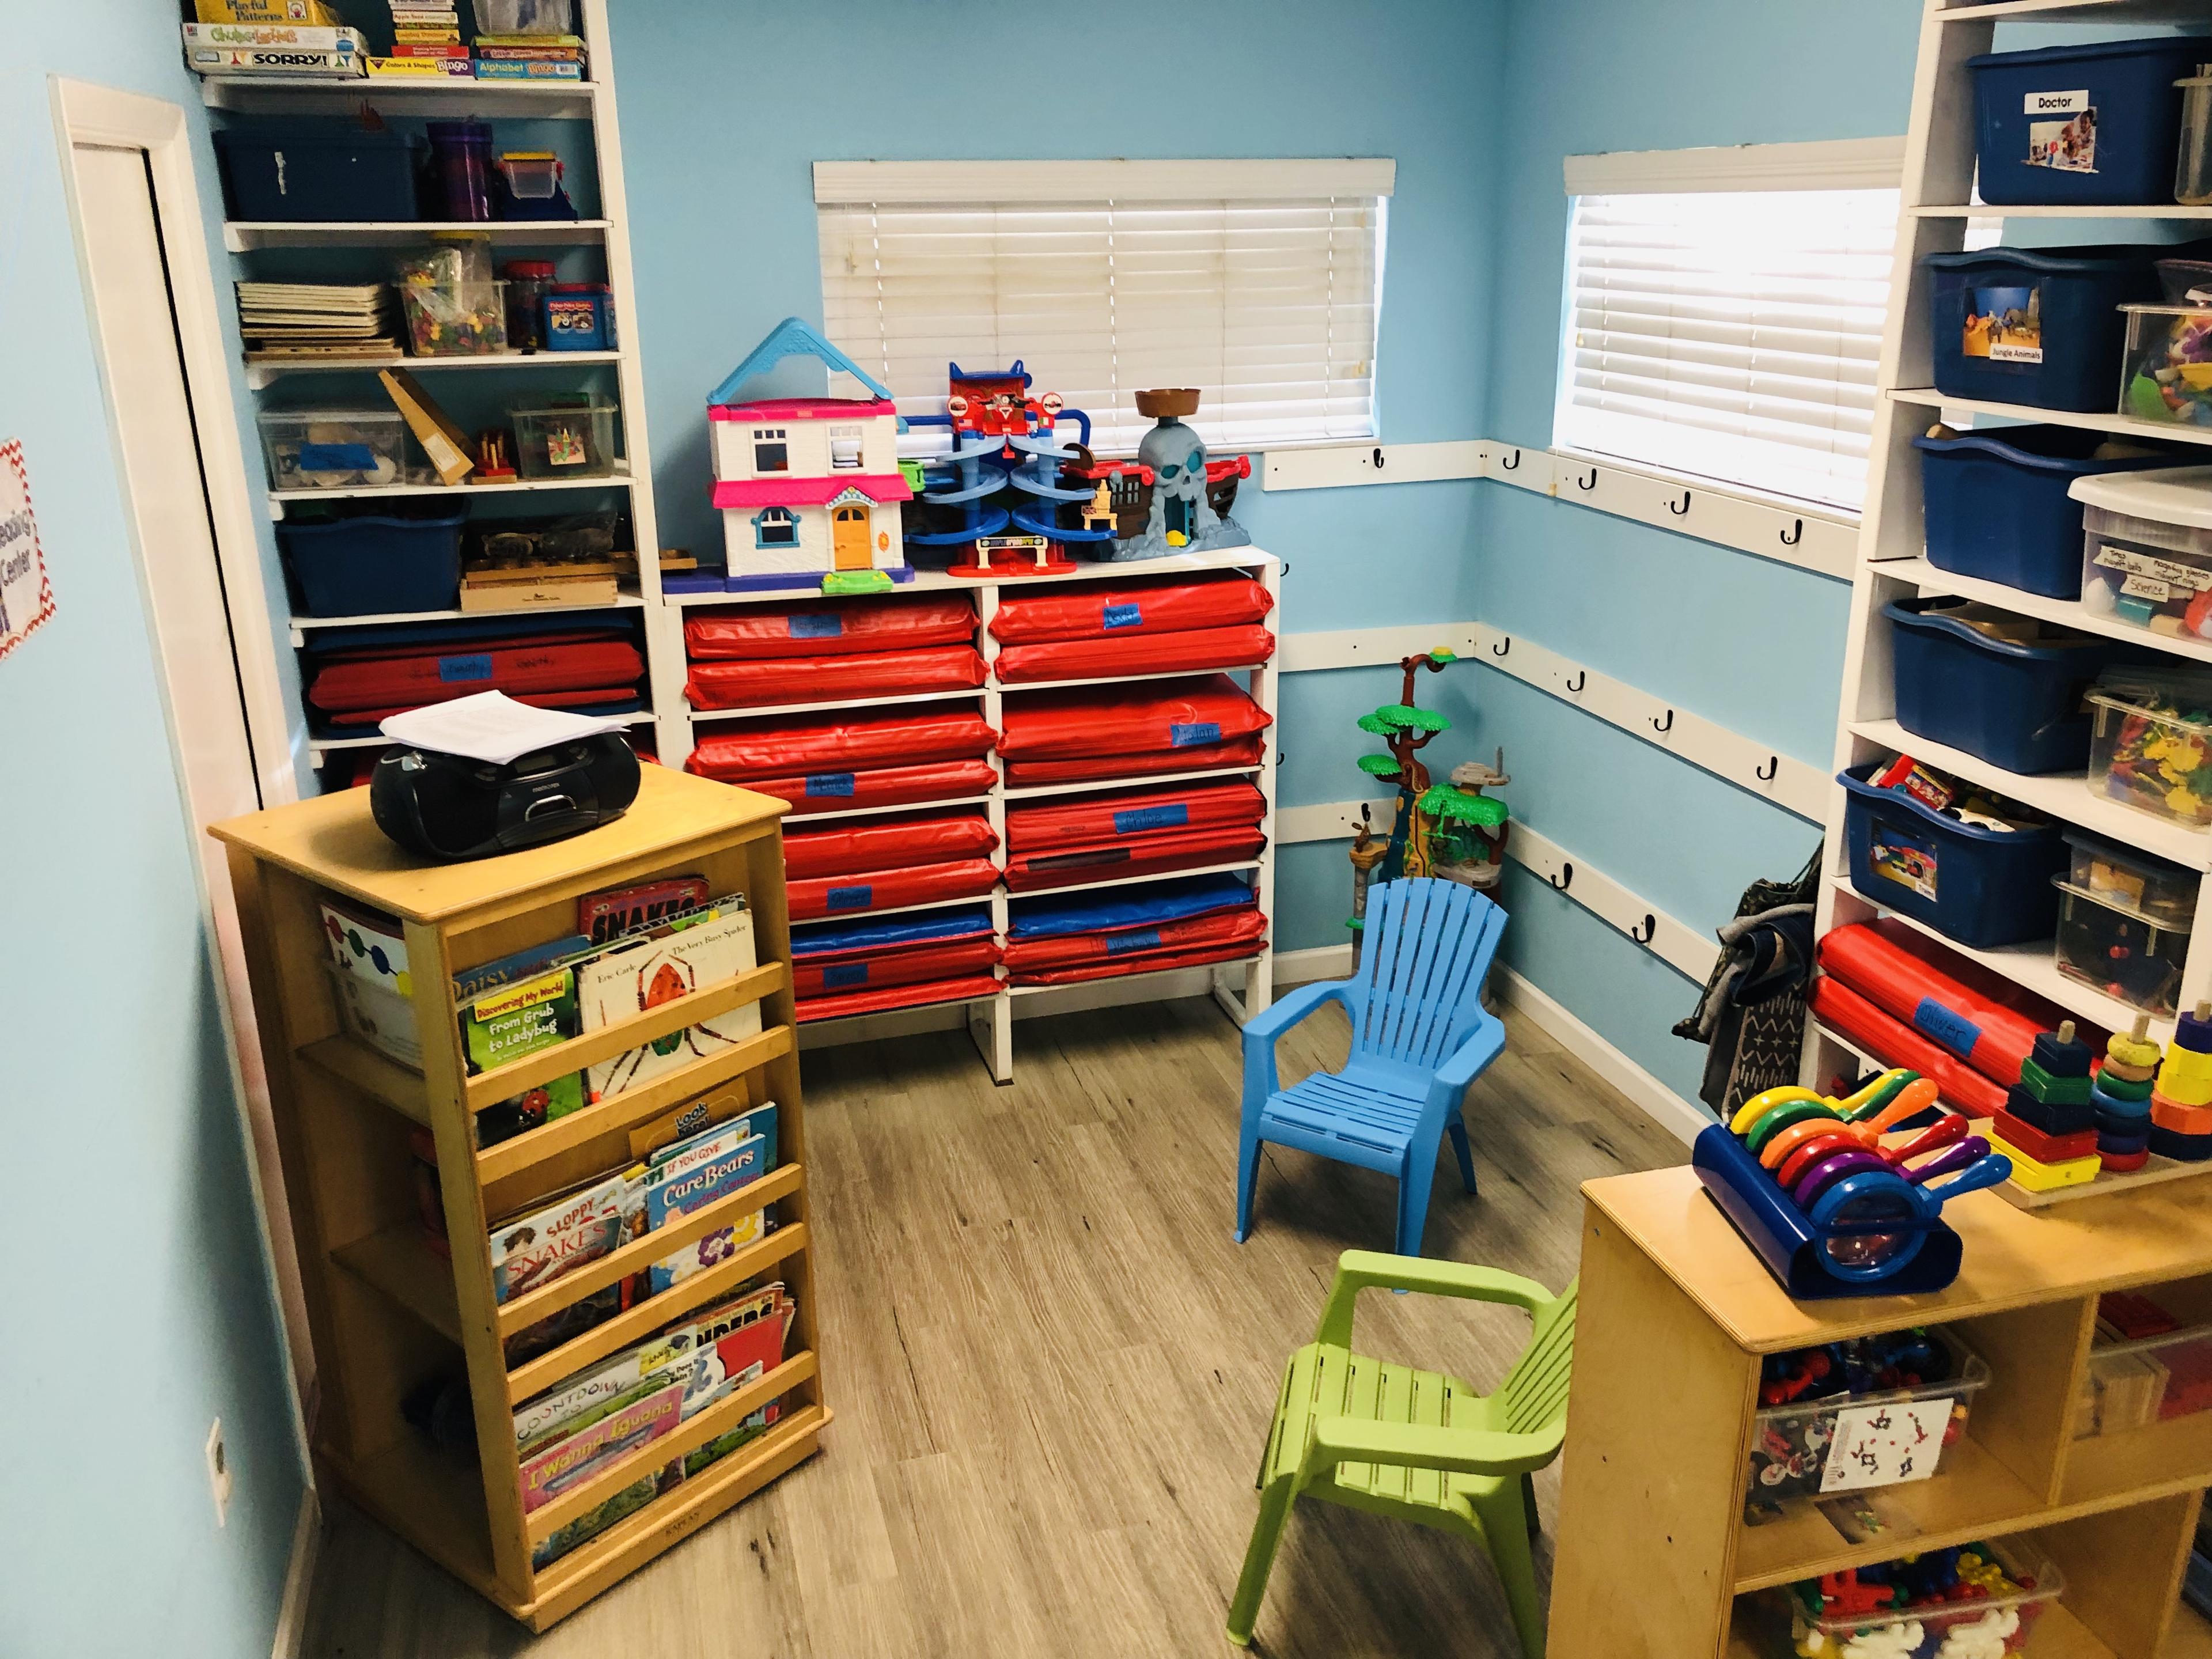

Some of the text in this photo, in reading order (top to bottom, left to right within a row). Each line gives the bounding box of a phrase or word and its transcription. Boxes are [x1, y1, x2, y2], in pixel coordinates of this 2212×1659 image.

[252, 53, 328, 66] SORRY!
[480, 63, 524, 72] Alphabet
[2039, 97, 2072, 108] Doctor
[1993, 347, 2040, 359] Jungle Animals
[672, 925, 747, 956] The Very Busy Spider
[597, 964, 637, 984] Eric Carle
[476, 980, 563, 1018] Discovering My World
[490, 1002, 554, 1035] From Grub
[490, 1040, 503, 1053] to
[506, 1018, 557, 1046] Ladybug
[675, 1101, 707, 1128] Look
[679, 1152, 697, 1168] YOU
[546, 1196, 595, 1238] SLOPPY
[528, 1472, 539, 1490] I
[543, 1434, 605, 1478] Wanna
[610, 1400, 674, 1438] Iguana
